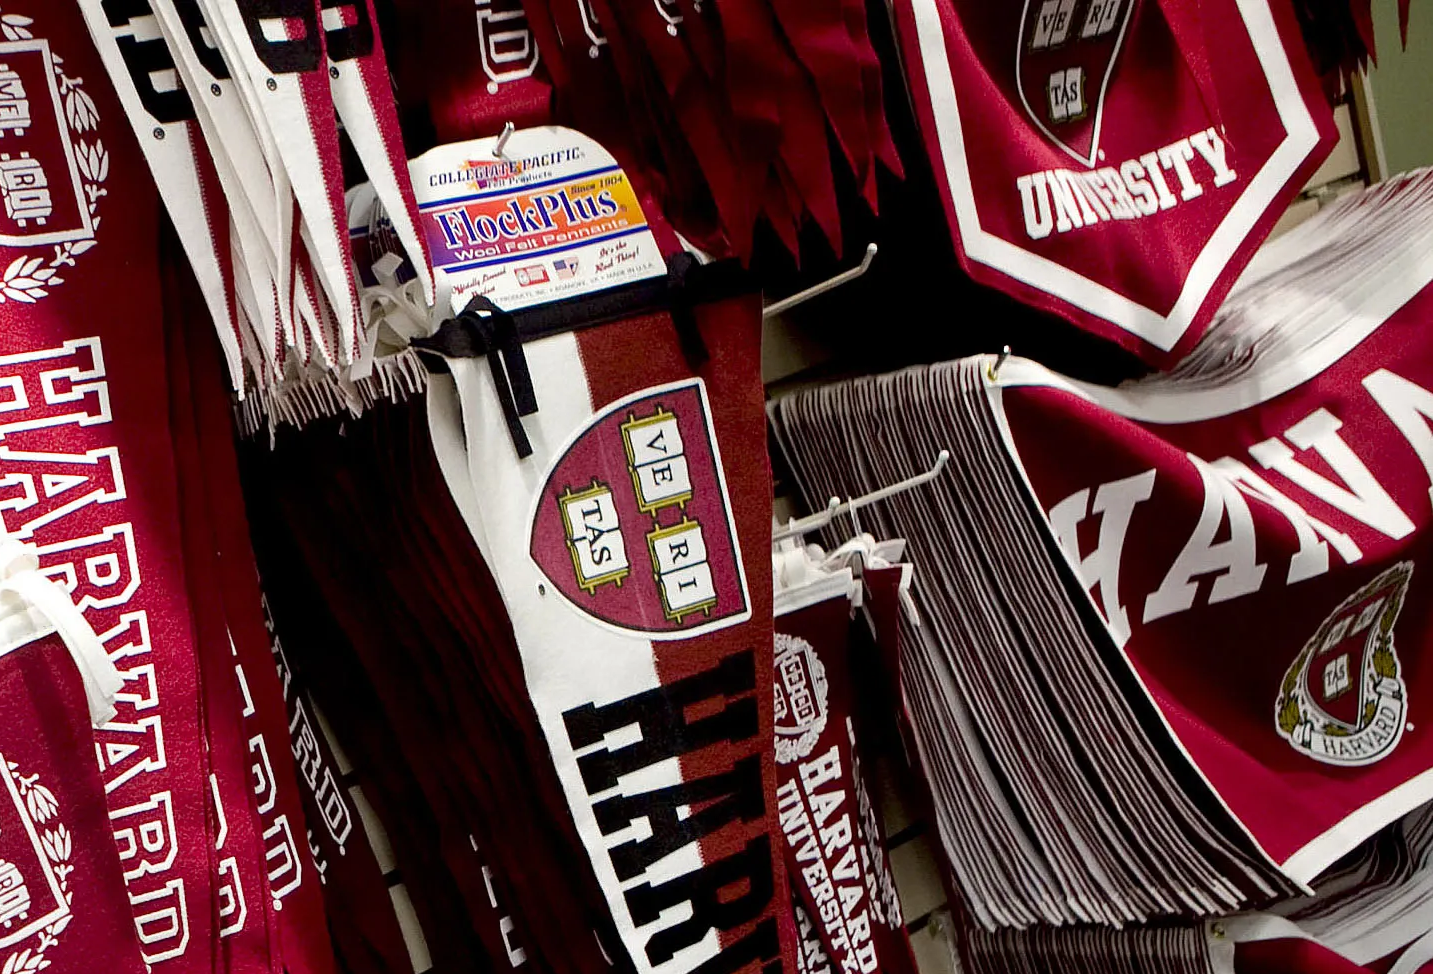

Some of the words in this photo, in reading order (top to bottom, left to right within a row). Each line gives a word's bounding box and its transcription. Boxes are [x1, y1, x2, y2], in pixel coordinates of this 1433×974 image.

[429, 160, 518, 187] COLLEGIATE
[454, 246, 501, 261] Wool
[507, 239, 539, 253] Felt
[542, 220, 629, 245] Pennants
[581, 498, 613, 567] TAS
[1323, 705, 1398, 758] HARVARD
[798, 744, 879, 974] HARVARD
